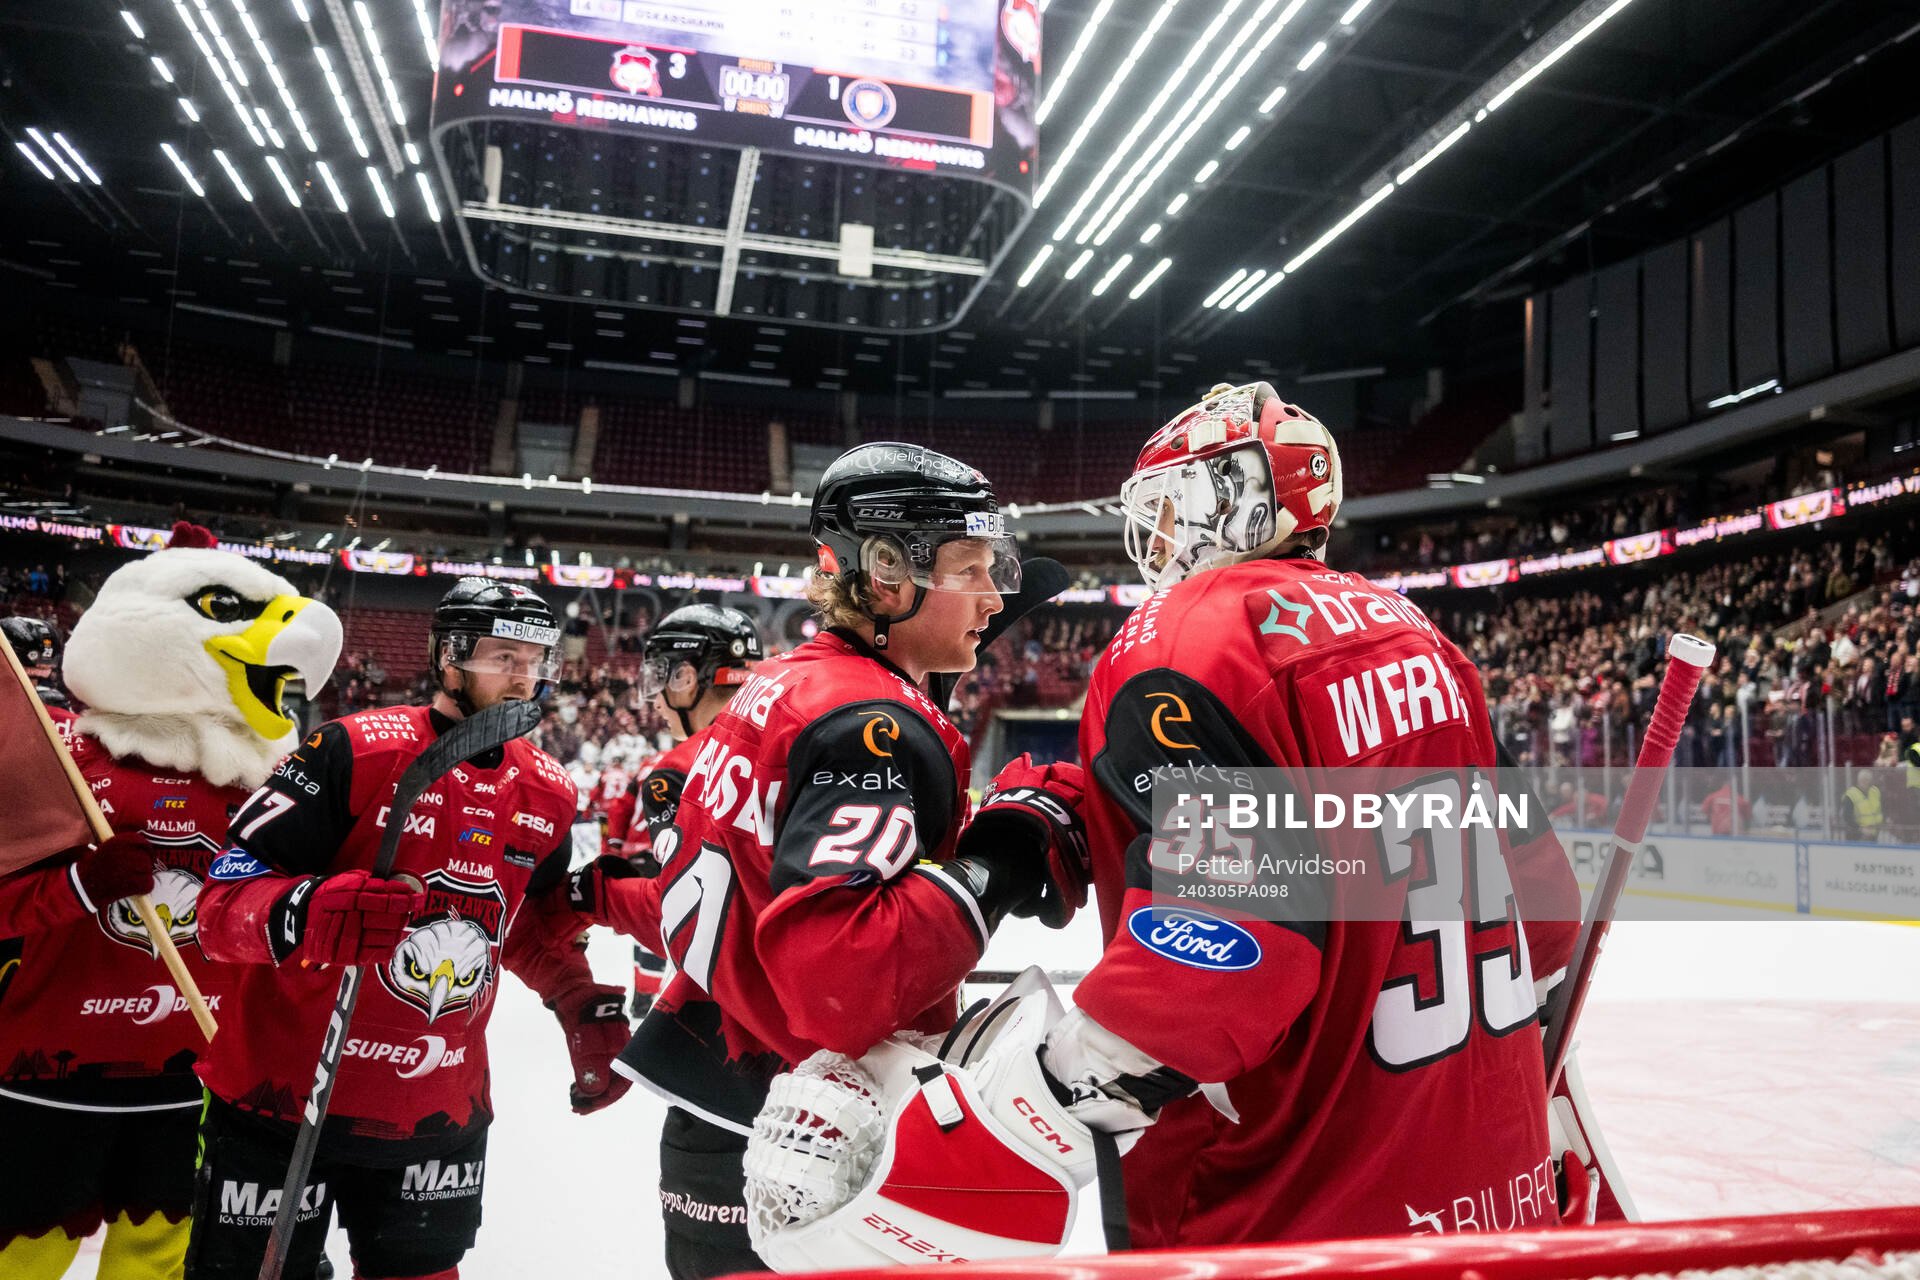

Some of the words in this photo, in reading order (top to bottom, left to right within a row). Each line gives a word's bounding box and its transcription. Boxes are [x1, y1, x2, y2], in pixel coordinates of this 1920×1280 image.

[668, 52, 687, 79] 3
[724, 70, 785, 102] 00:00
[828, 75, 840, 101] 1
[488, 88, 575, 114] MALMÖ
[576, 97, 697, 131] REDHAWKS
[794, 126, 874, 154] MALMÖ
[874, 136, 985, 170] REDHAWKS
[858, 508, 904, 519] CCM
[523, 616, 549, 627] CCM
[1123, 601, 1145, 655] RENA
[672, 641, 700, 650] CCM
[1110, 624, 1124, 667] TEL
[354, 713, 410, 724] MALMÖ
[361, 722, 415, 732] ARENA
[365, 731, 419, 743] HOTEL
[152, 777, 192, 785] CCM
[473, 782, 497, 796] SHL
[1134, 759, 1254, 793] exakta
[147, 819, 196, 833] MALMÖ
[518, 812, 554, 838] RSA
[809, 802, 918, 882] 20
[1148, 795, 1255, 886] 35
[446, 858, 495, 880] MALMÖ
[1573, 841, 1664, 880] RA
[412, 888, 502, 936] EDHAWKS
[1370, 766, 1540, 1075] 35
[1150, 913, 1239, 963] Ford
[80, 997, 152, 1015] SUPER
[342, 1038, 421, 1066] SUPER
[1012, 1096, 1075, 1154] CCM
[401, 1159, 484, 1192] MAXI
[417, 1186, 480, 1202] STORMARKNAD
